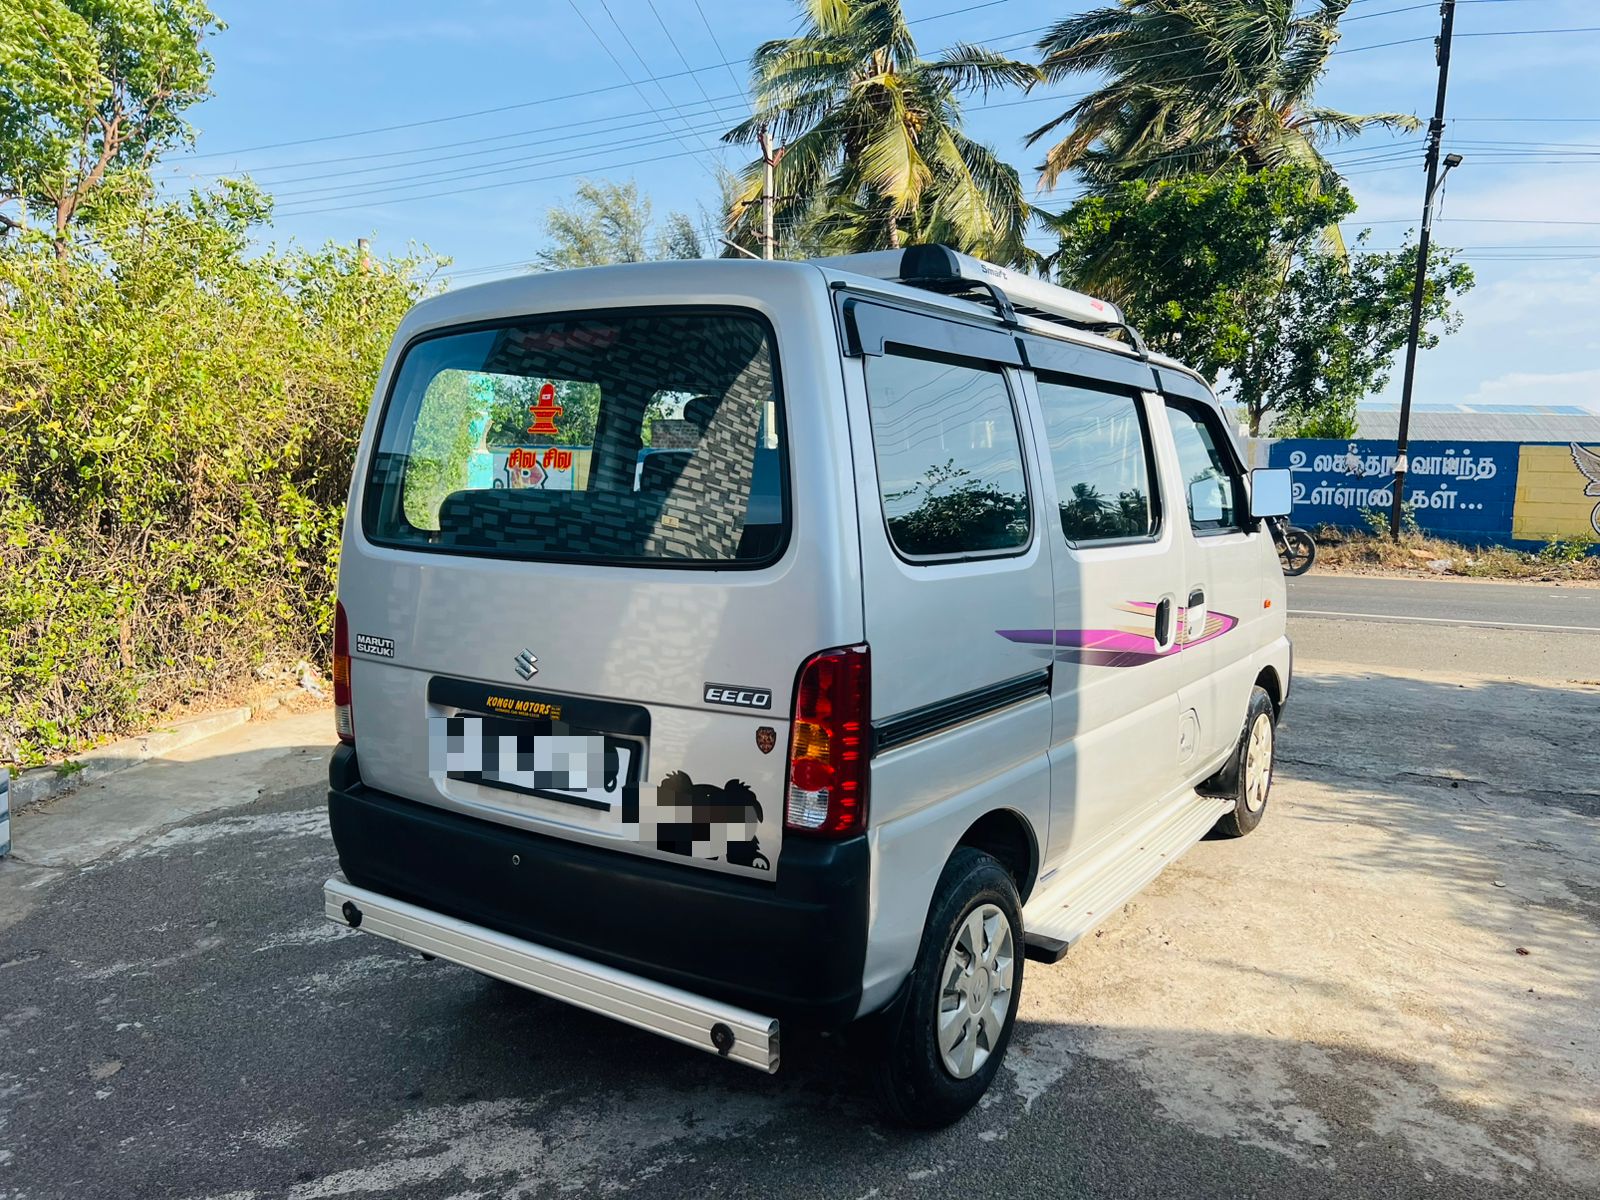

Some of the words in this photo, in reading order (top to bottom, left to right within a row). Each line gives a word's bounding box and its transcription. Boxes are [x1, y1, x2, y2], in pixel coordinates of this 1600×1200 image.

[980, 264, 1008, 280] Smart
[357, 634, 394, 649] MARUTI
[357, 643, 394, 657] SUZUKI
[486, 695, 515, 710] KONGU
[515, 700, 552, 715] MOTORS
[705, 688, 770, 706] EECO
